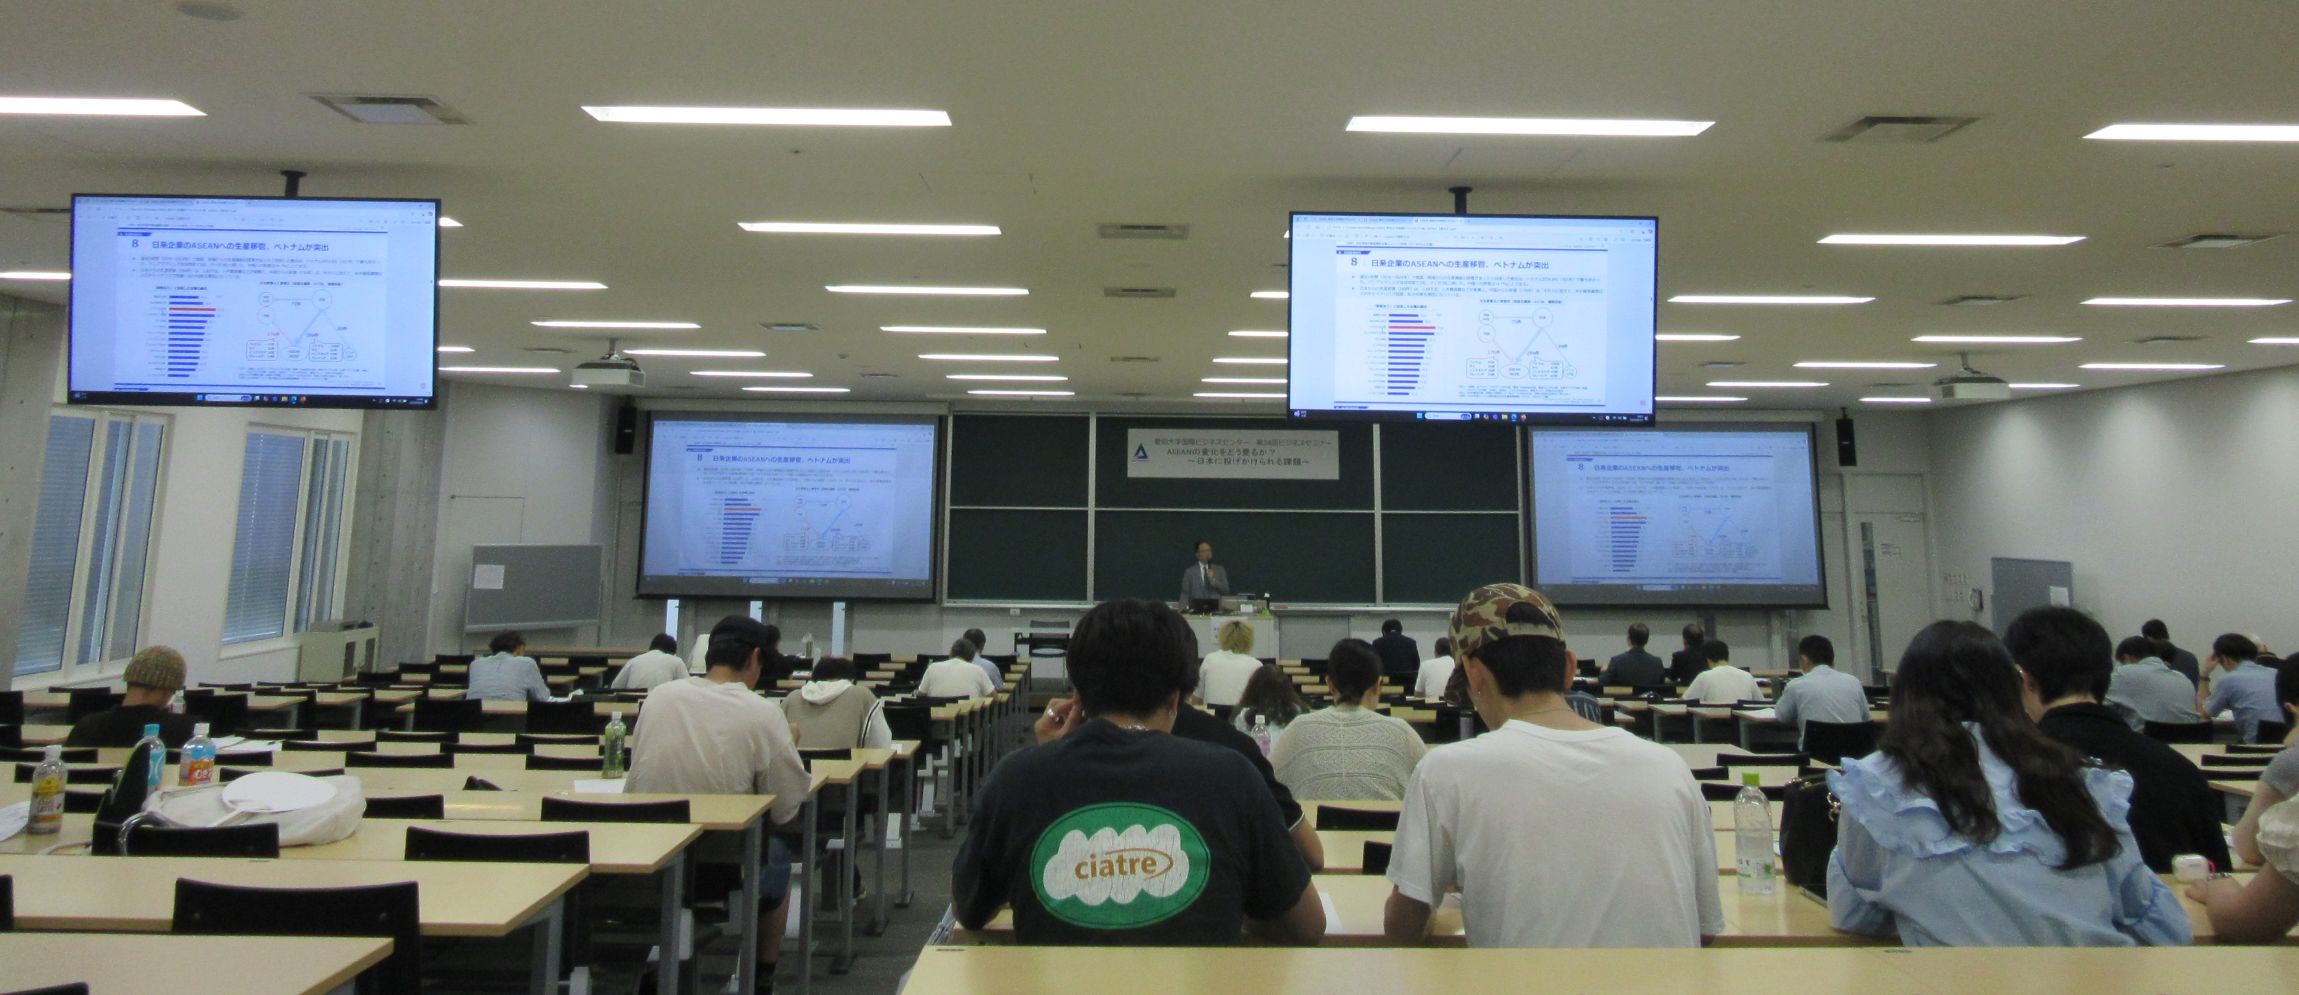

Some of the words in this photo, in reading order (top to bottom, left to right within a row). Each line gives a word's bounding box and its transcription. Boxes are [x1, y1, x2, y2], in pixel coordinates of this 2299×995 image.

[131, 239, 139, 248] 8
[1350, 257, 1358, 267] 8
[1074, 853, 1158, 880] ciatre
